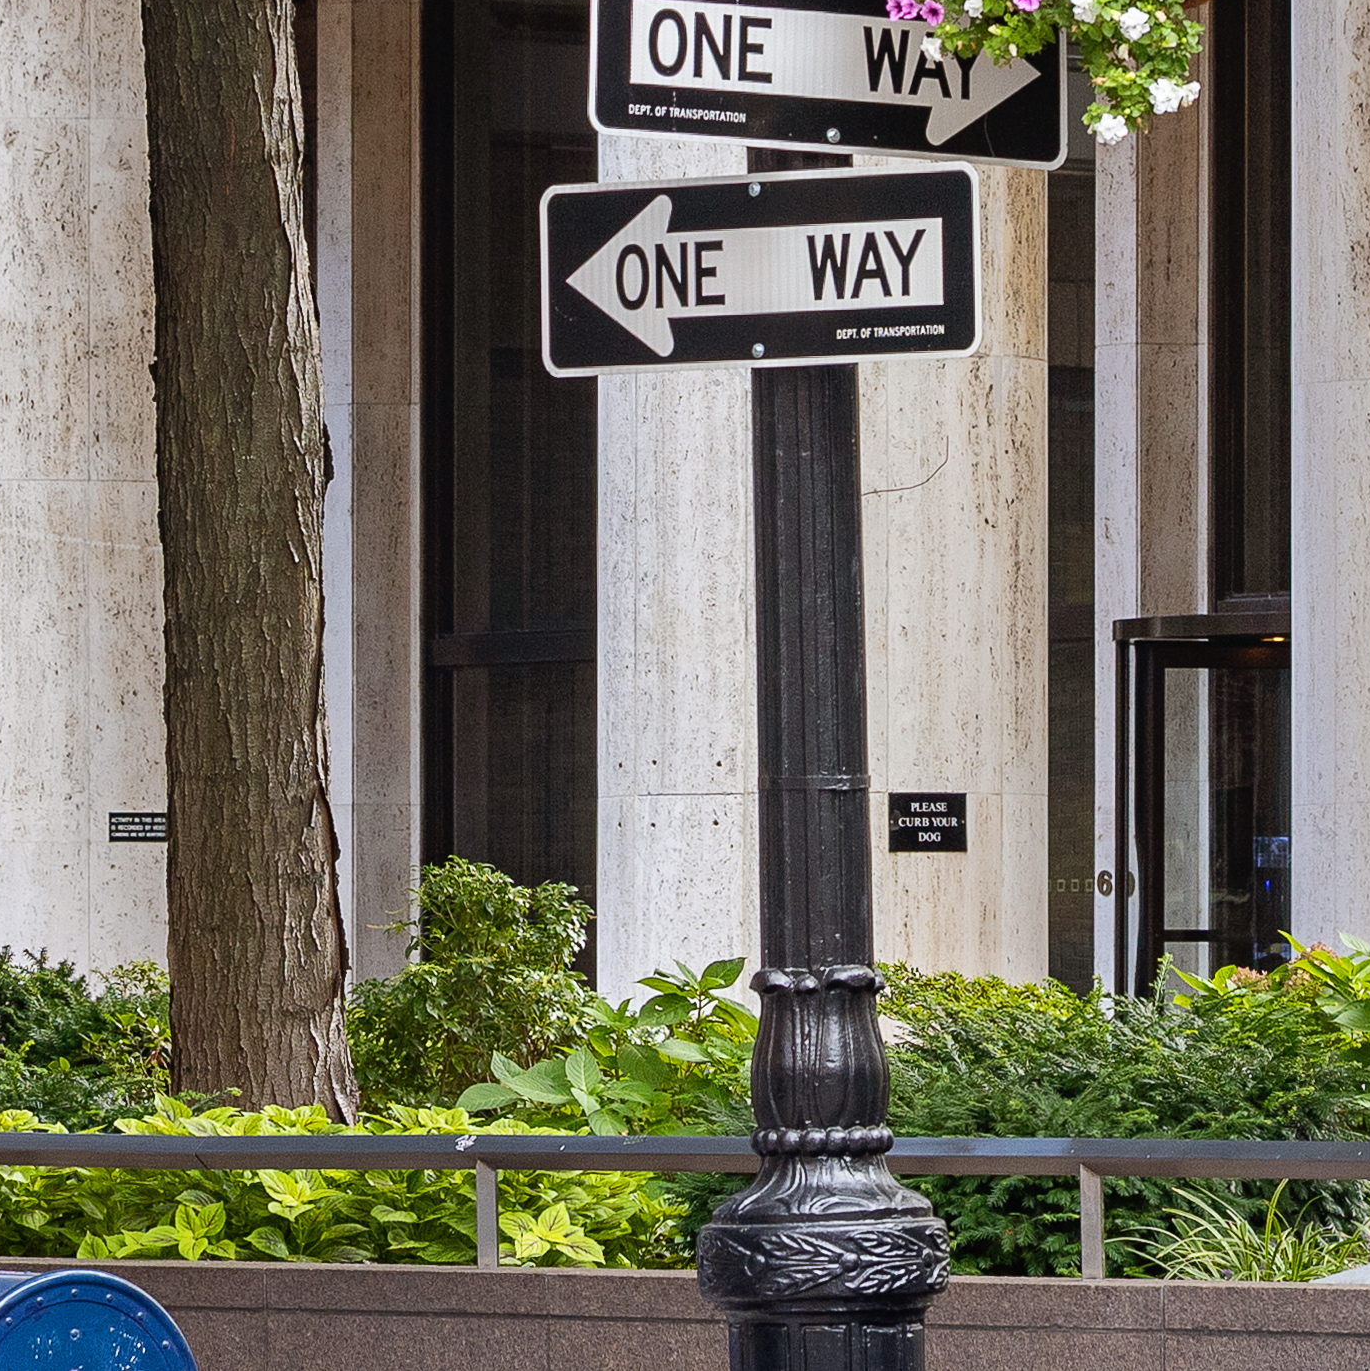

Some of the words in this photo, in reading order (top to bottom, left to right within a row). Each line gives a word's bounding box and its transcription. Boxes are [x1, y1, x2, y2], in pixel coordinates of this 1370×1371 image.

[648, 7, 773, 85] ONE
[862, 25, 981, 101] WAY
[628, 103, 653, 117] DEPT.
[654, 105, 668, 117] OF
[669, 106, 747, 123] TRANSPORTATION
[615, 239, 726, 311] ONE
[807, 228, 927, 301] WAY
[835, 328, 859, 340] DEPT.
[860, 327, 872, 339] OF
[874, 324, 945, 338] TRANSPORTATION
[910, 802, 948, 812] PLEASE
[898, 817, 930, 827] CURB
[931, 817, 958, 827] YOUR
[918, 832, 942, 842] DOG
